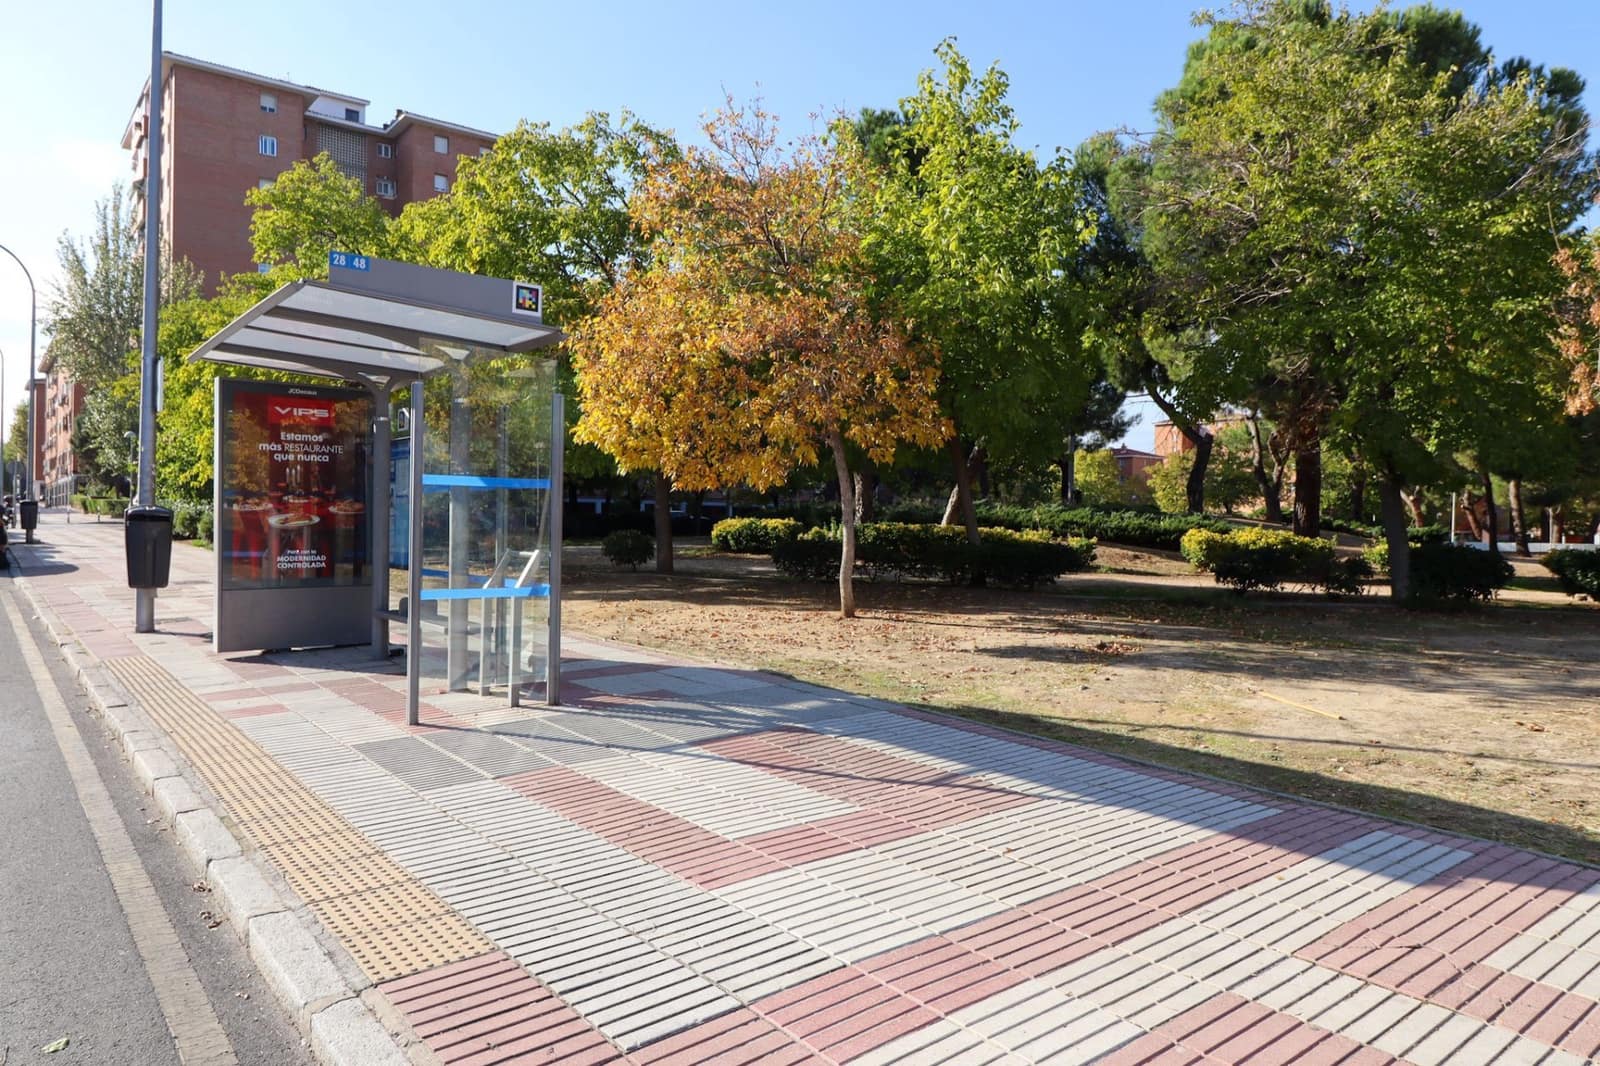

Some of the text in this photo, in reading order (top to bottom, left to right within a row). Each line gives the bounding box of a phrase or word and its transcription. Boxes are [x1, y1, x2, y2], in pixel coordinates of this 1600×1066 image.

[333, 254, 366, 269] 28 48
[274, 406, 329, 417] VIPS
[280, 432, 323, 442] Estamos
[258, 442, 344, 454] más RESTAURANTE
[273, 453, 329, 462] que nunca
